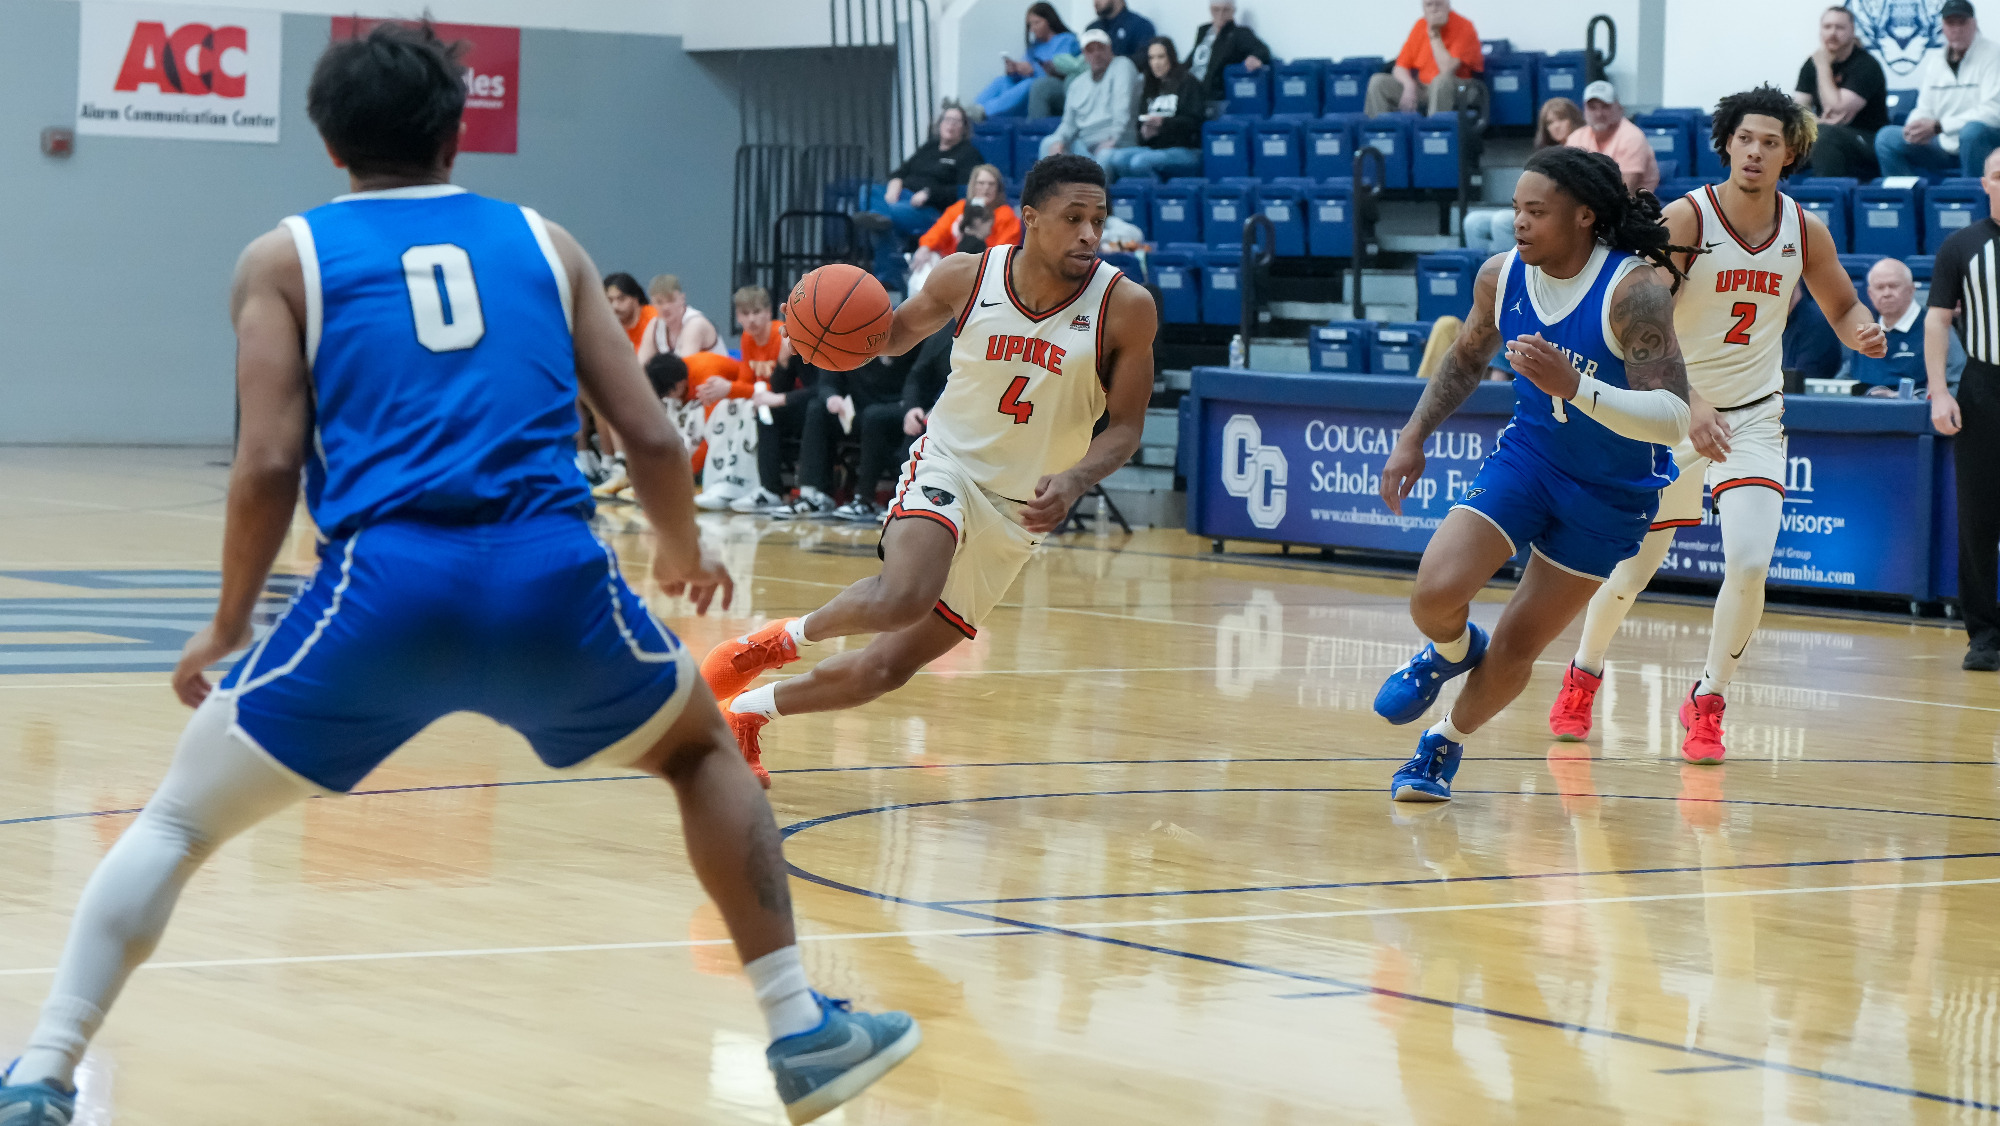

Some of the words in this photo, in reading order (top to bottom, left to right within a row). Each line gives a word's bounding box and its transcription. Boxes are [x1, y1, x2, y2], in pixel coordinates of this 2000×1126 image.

[113, 20, 248, 99] ACC
[79, 104, 120, 121] Alarm
[124, 105, 228, 126] Communication
[232, 109, 276, 128] Center
[401, 242, 486, 353] 0
[1716, 269, 1783, 297] UPIKE
[1724, 302, 1758, 346] 2
[985, 334, 1067, 377] UPIKE
[998, 375, 1034, 424] 4
[1786, 547, 1812, 561] Group
